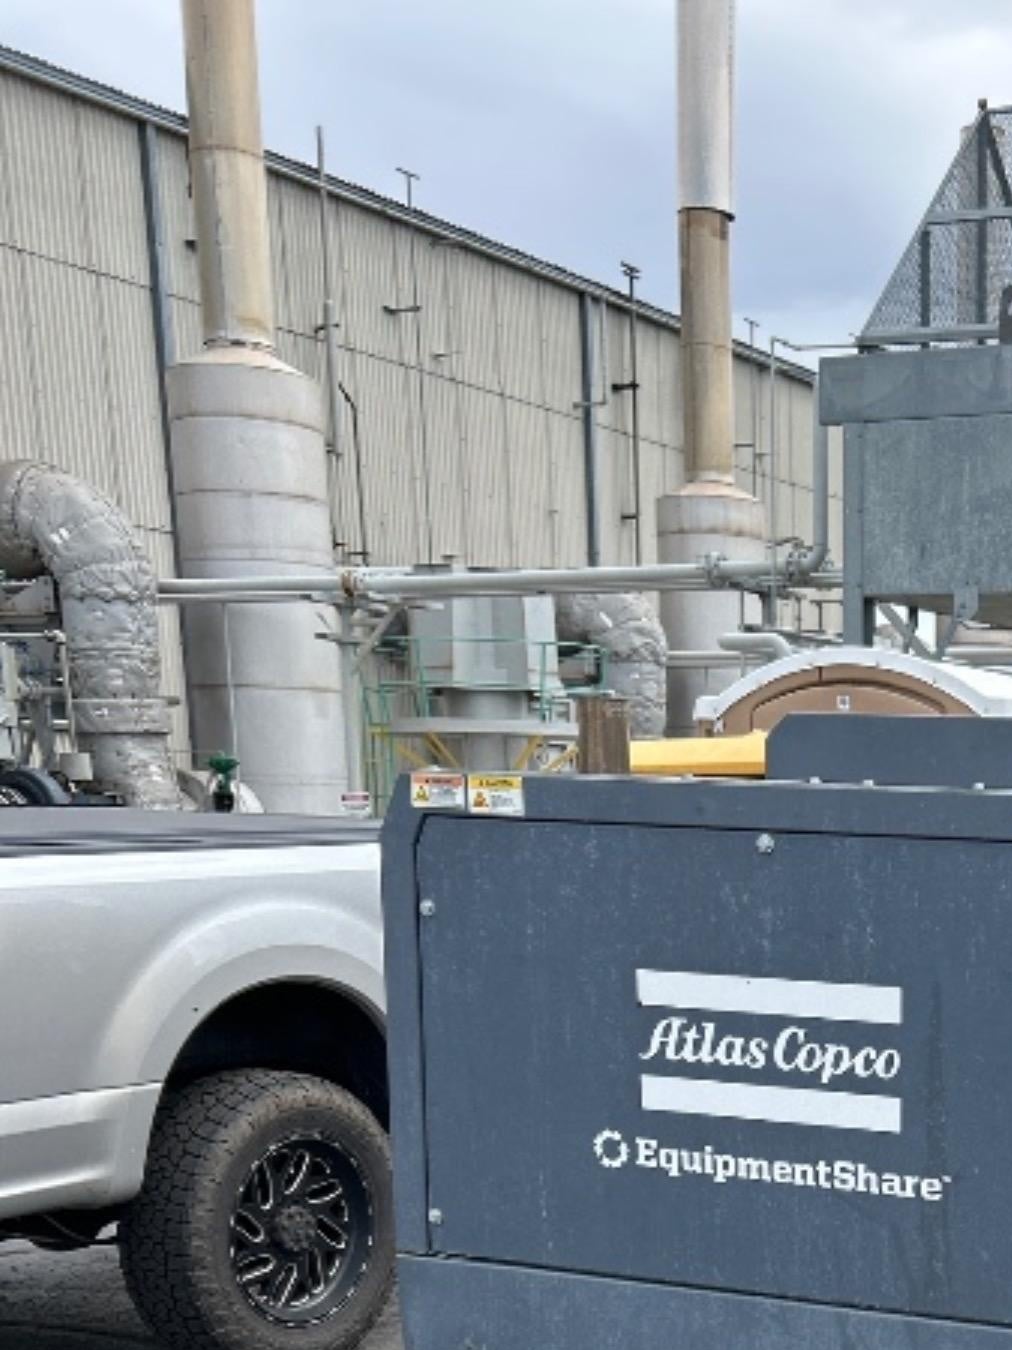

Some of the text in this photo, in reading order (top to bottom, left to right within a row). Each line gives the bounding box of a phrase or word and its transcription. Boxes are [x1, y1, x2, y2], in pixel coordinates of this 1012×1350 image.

[639, 1016, 900, 1084] Atlas Copco
[635, 1137, 943, 1201] EquipmentShare
